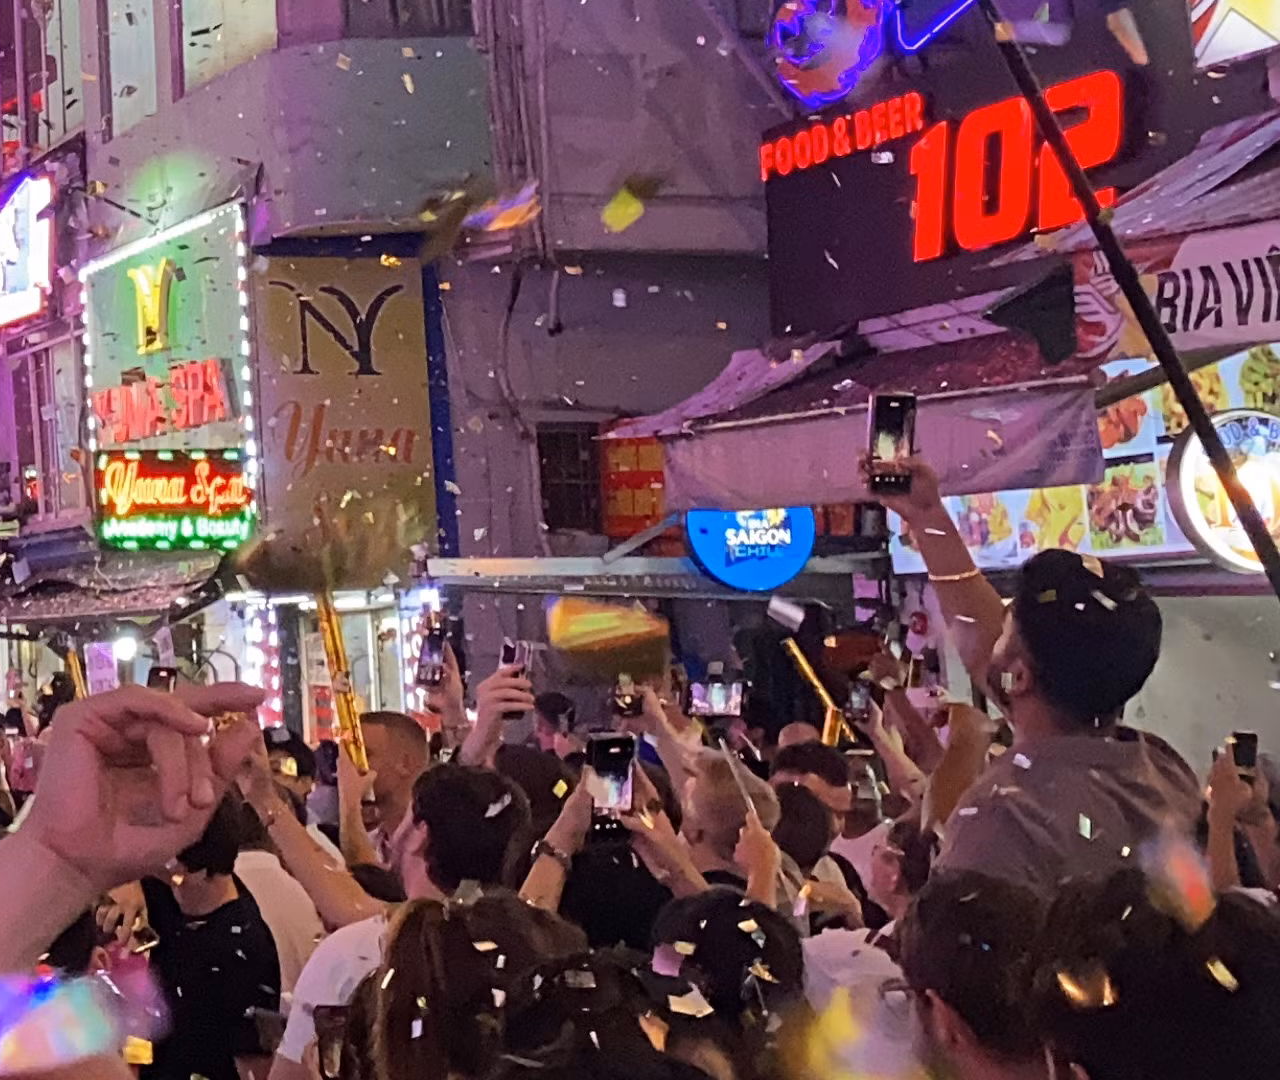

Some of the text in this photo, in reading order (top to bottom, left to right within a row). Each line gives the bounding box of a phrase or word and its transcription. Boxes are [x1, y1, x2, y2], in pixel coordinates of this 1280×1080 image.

[760, 92, 924, 182] FOOD & BEER
[910, 70, 1124, 262] 102
[268, 280, 404, 376] NY
[1156, 265, 1223, 334] BIA
[190, 460, 248, 516] Spa
[724, 528, 791, 546] SAIGON
